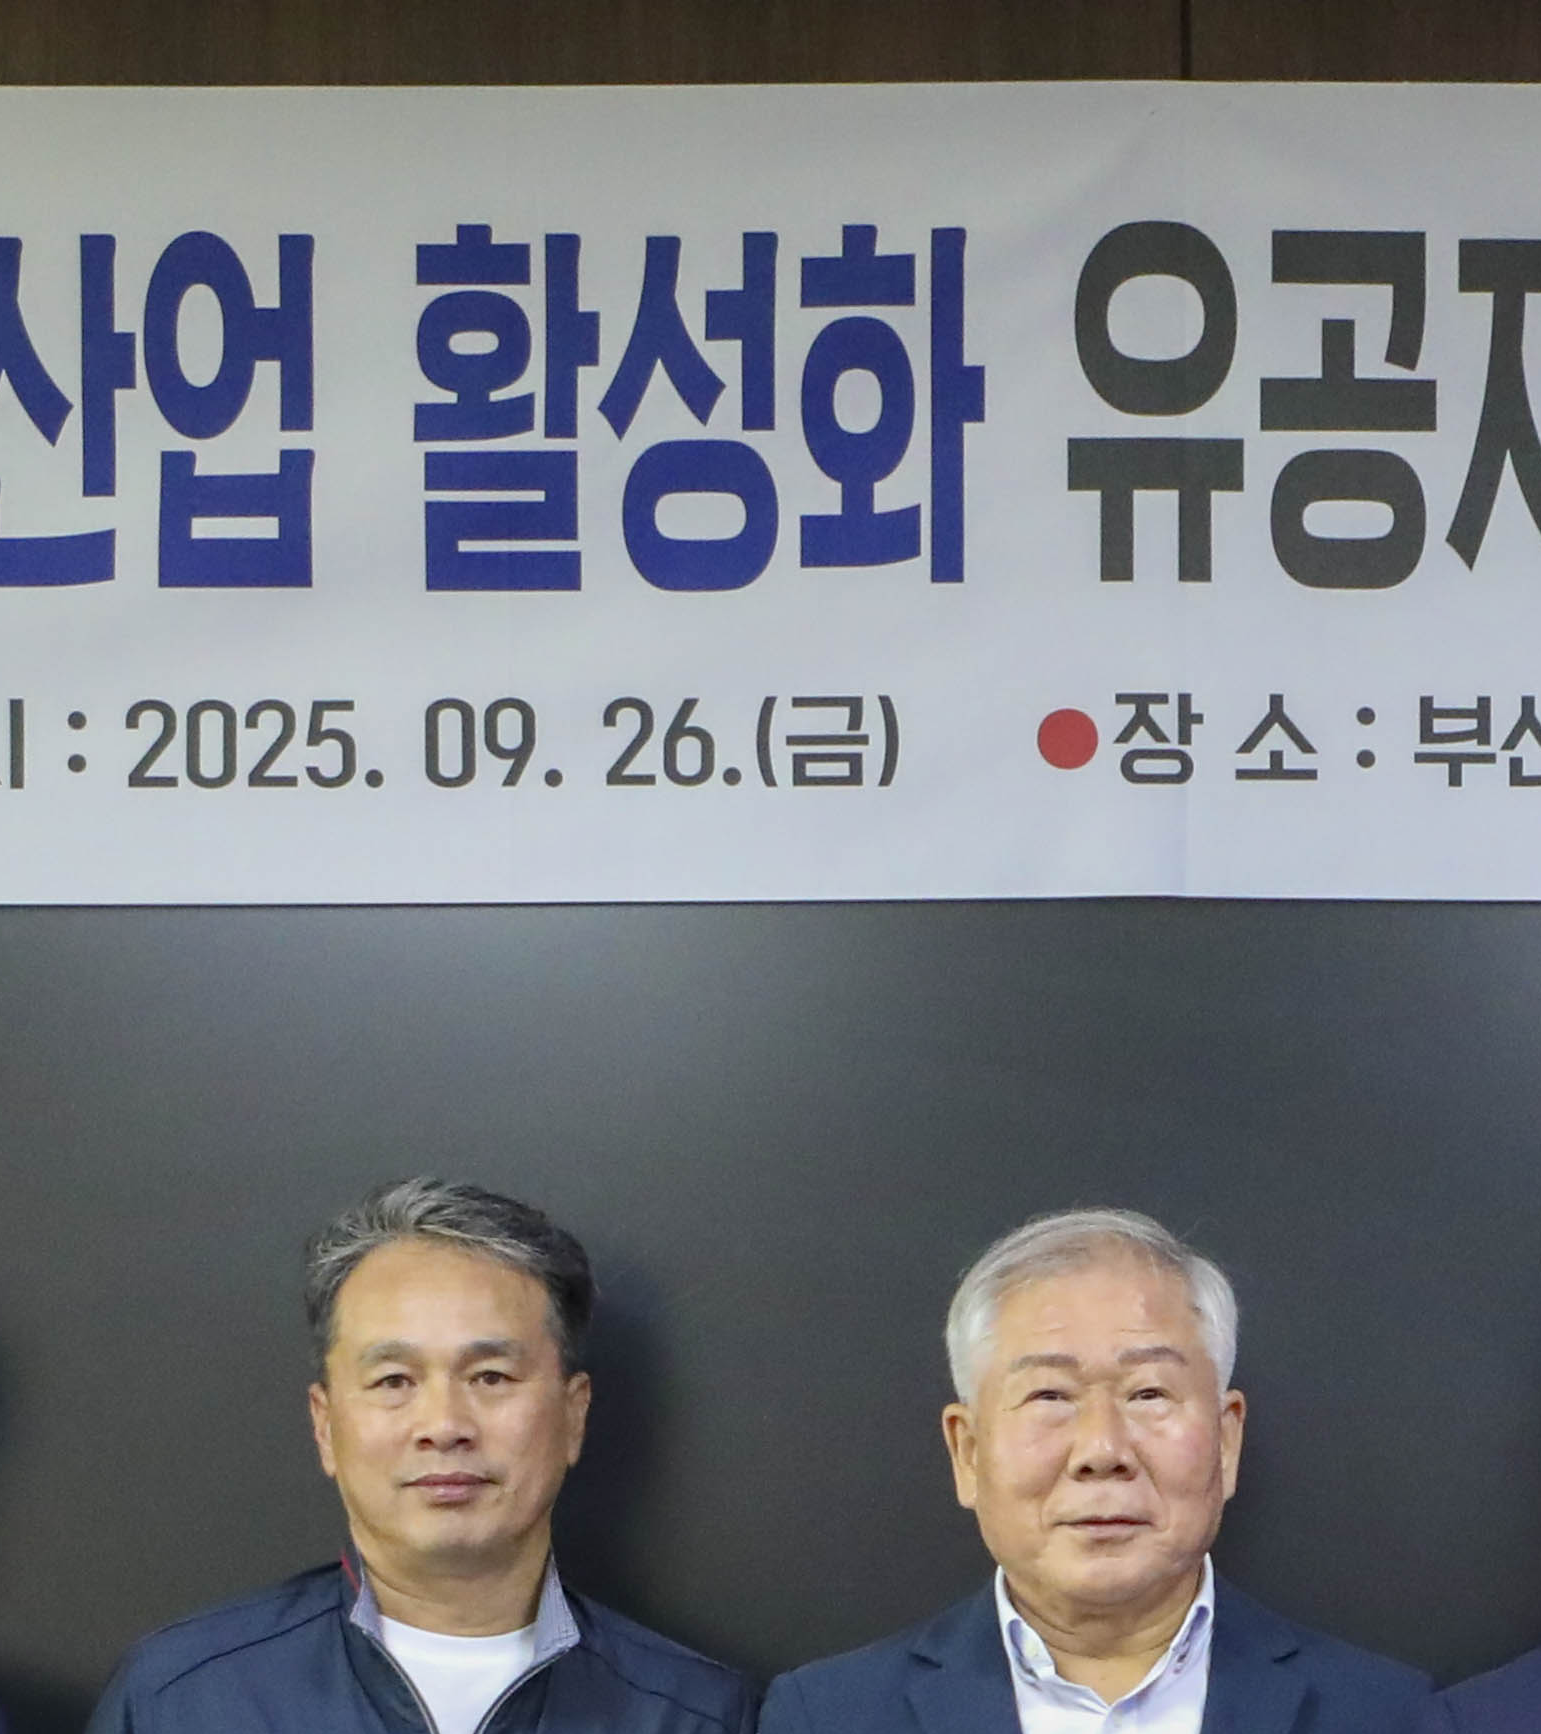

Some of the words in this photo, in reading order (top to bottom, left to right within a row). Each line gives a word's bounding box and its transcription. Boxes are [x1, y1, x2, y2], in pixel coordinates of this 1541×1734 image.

[414, 224, 986, 591] 활성화
[126, 700, 383, 788] 2025.
[426, 699, 562, 787] 09.
[604, 696, 899, 787] 26.(금)
